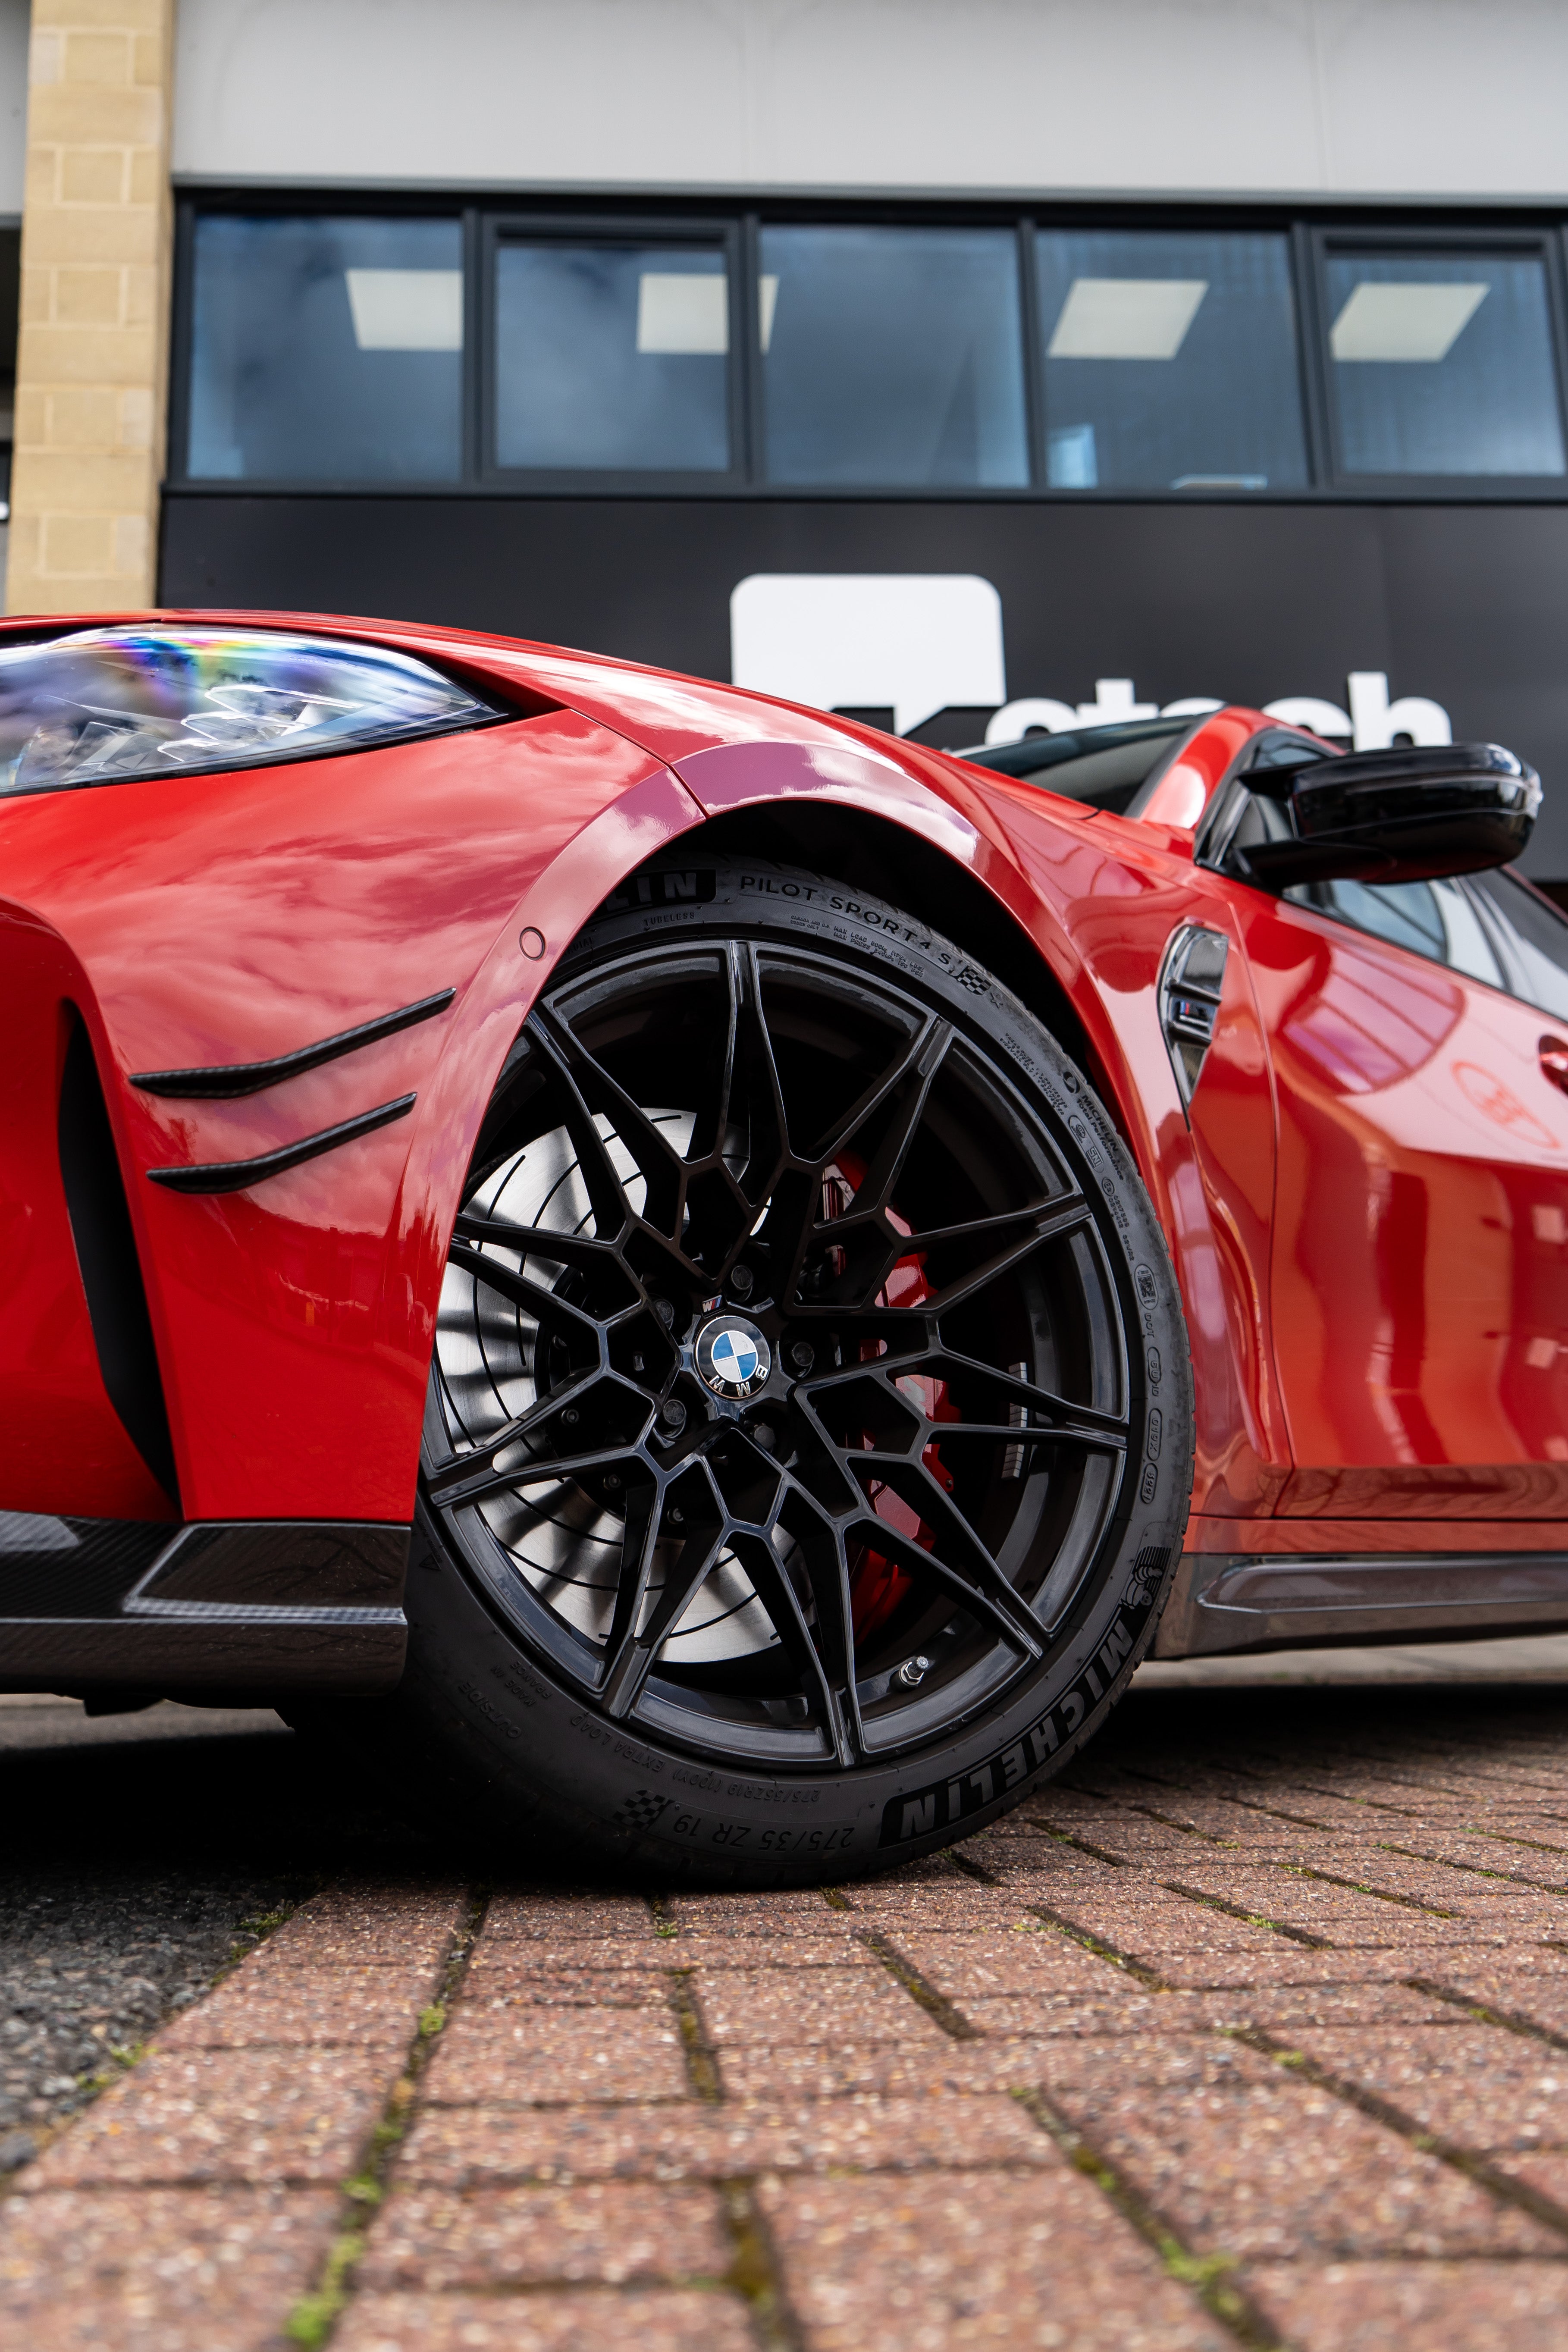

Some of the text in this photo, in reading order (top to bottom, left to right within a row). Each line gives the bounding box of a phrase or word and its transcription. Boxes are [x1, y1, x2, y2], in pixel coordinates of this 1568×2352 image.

[644, 913, 695, 926] TUBELESS
[740, 875, 952, 966] PILOT SPORT 4 S
[1076, 1098, 1093, 1120] Total
[1091, 1122, 1124, 1181] Performance
[1082, 1095, 1119, 1152] MICHELIN
[1088, 1148, 1103, 1168] SNI
[1144, 1313, 1154, 1338] DOT
[709, 1364, 769, 1398] BMW
[490, 1665, 537, 1706] MADE IN
[509, 1661, 553, 1699] FRANCE
[458, 1682, 522, 1739] OUTSIDE
[900, 1620, 1133, 1839] MICHELIN
[571, 1715, 820, 1803] 275/35ZR19 (100Y) EXTRA LOAD
[673, 1814, 856, 1852] 275/35 ZR 19
